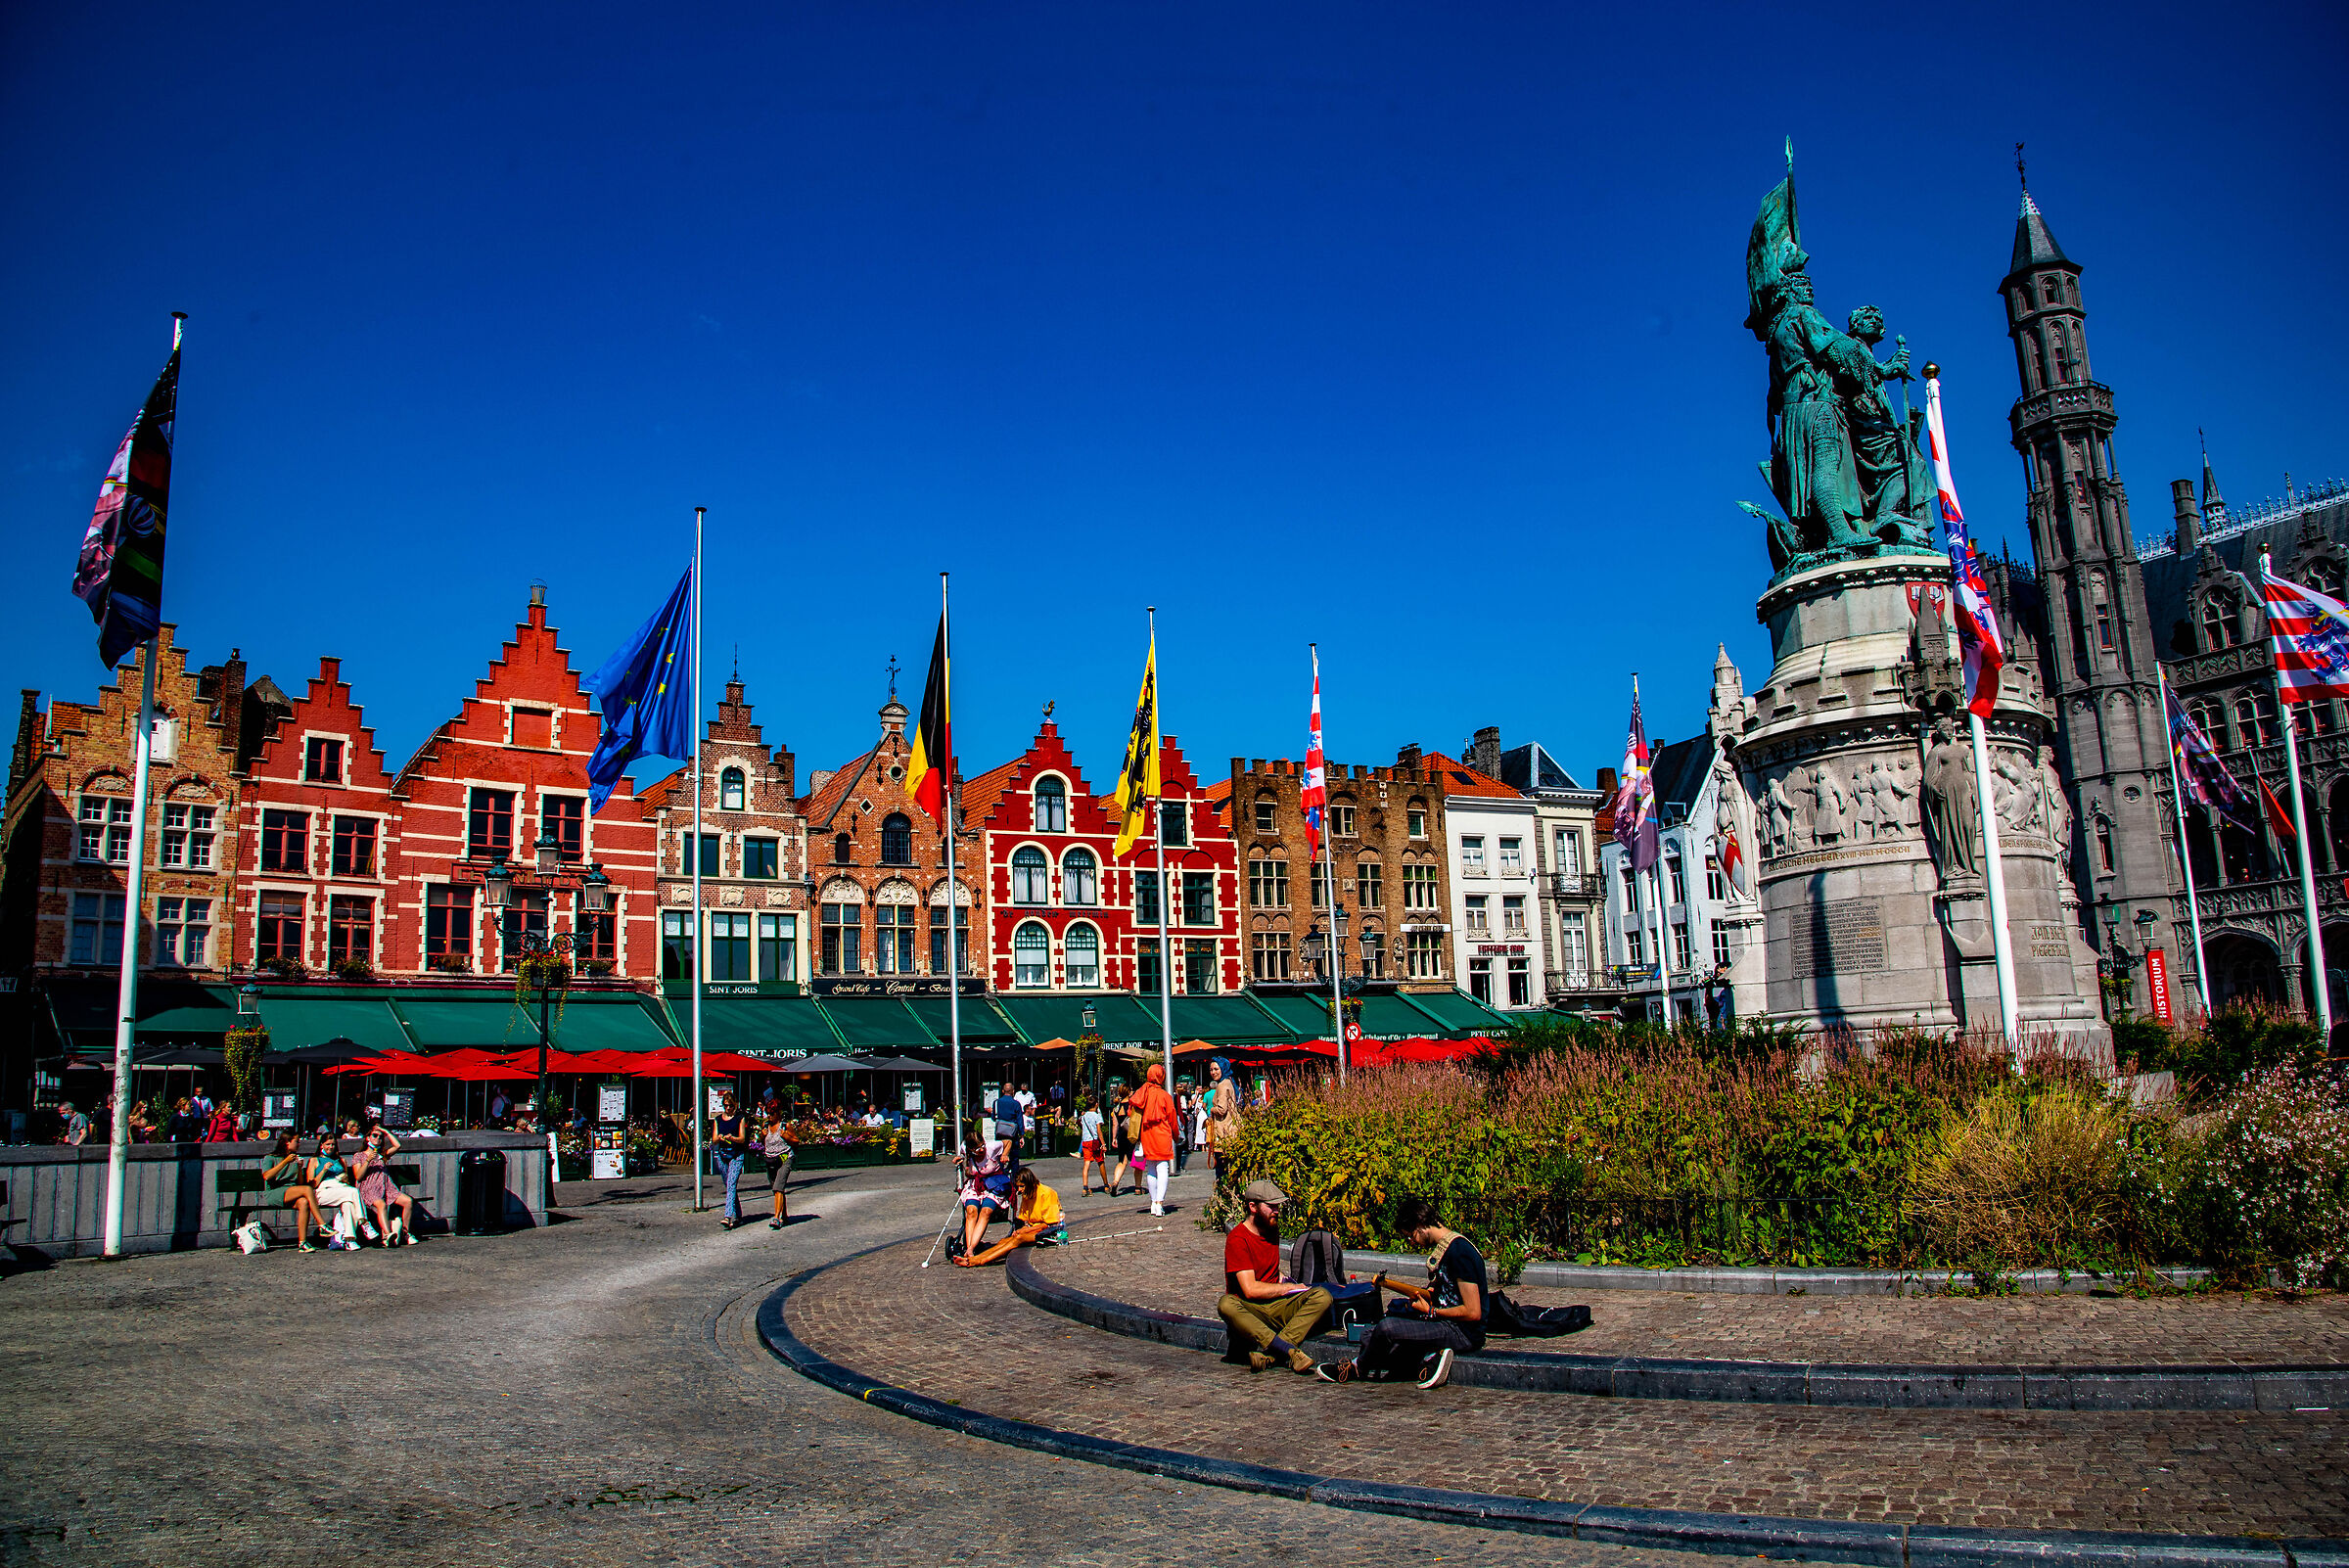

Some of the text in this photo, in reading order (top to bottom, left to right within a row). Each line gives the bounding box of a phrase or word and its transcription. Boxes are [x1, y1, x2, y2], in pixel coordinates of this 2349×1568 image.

[709, 985, 759, 994] SINT JORIS
[885, 980, 916, 995] Central
[2151, 958, 2167, 1019] HISTORIUM
